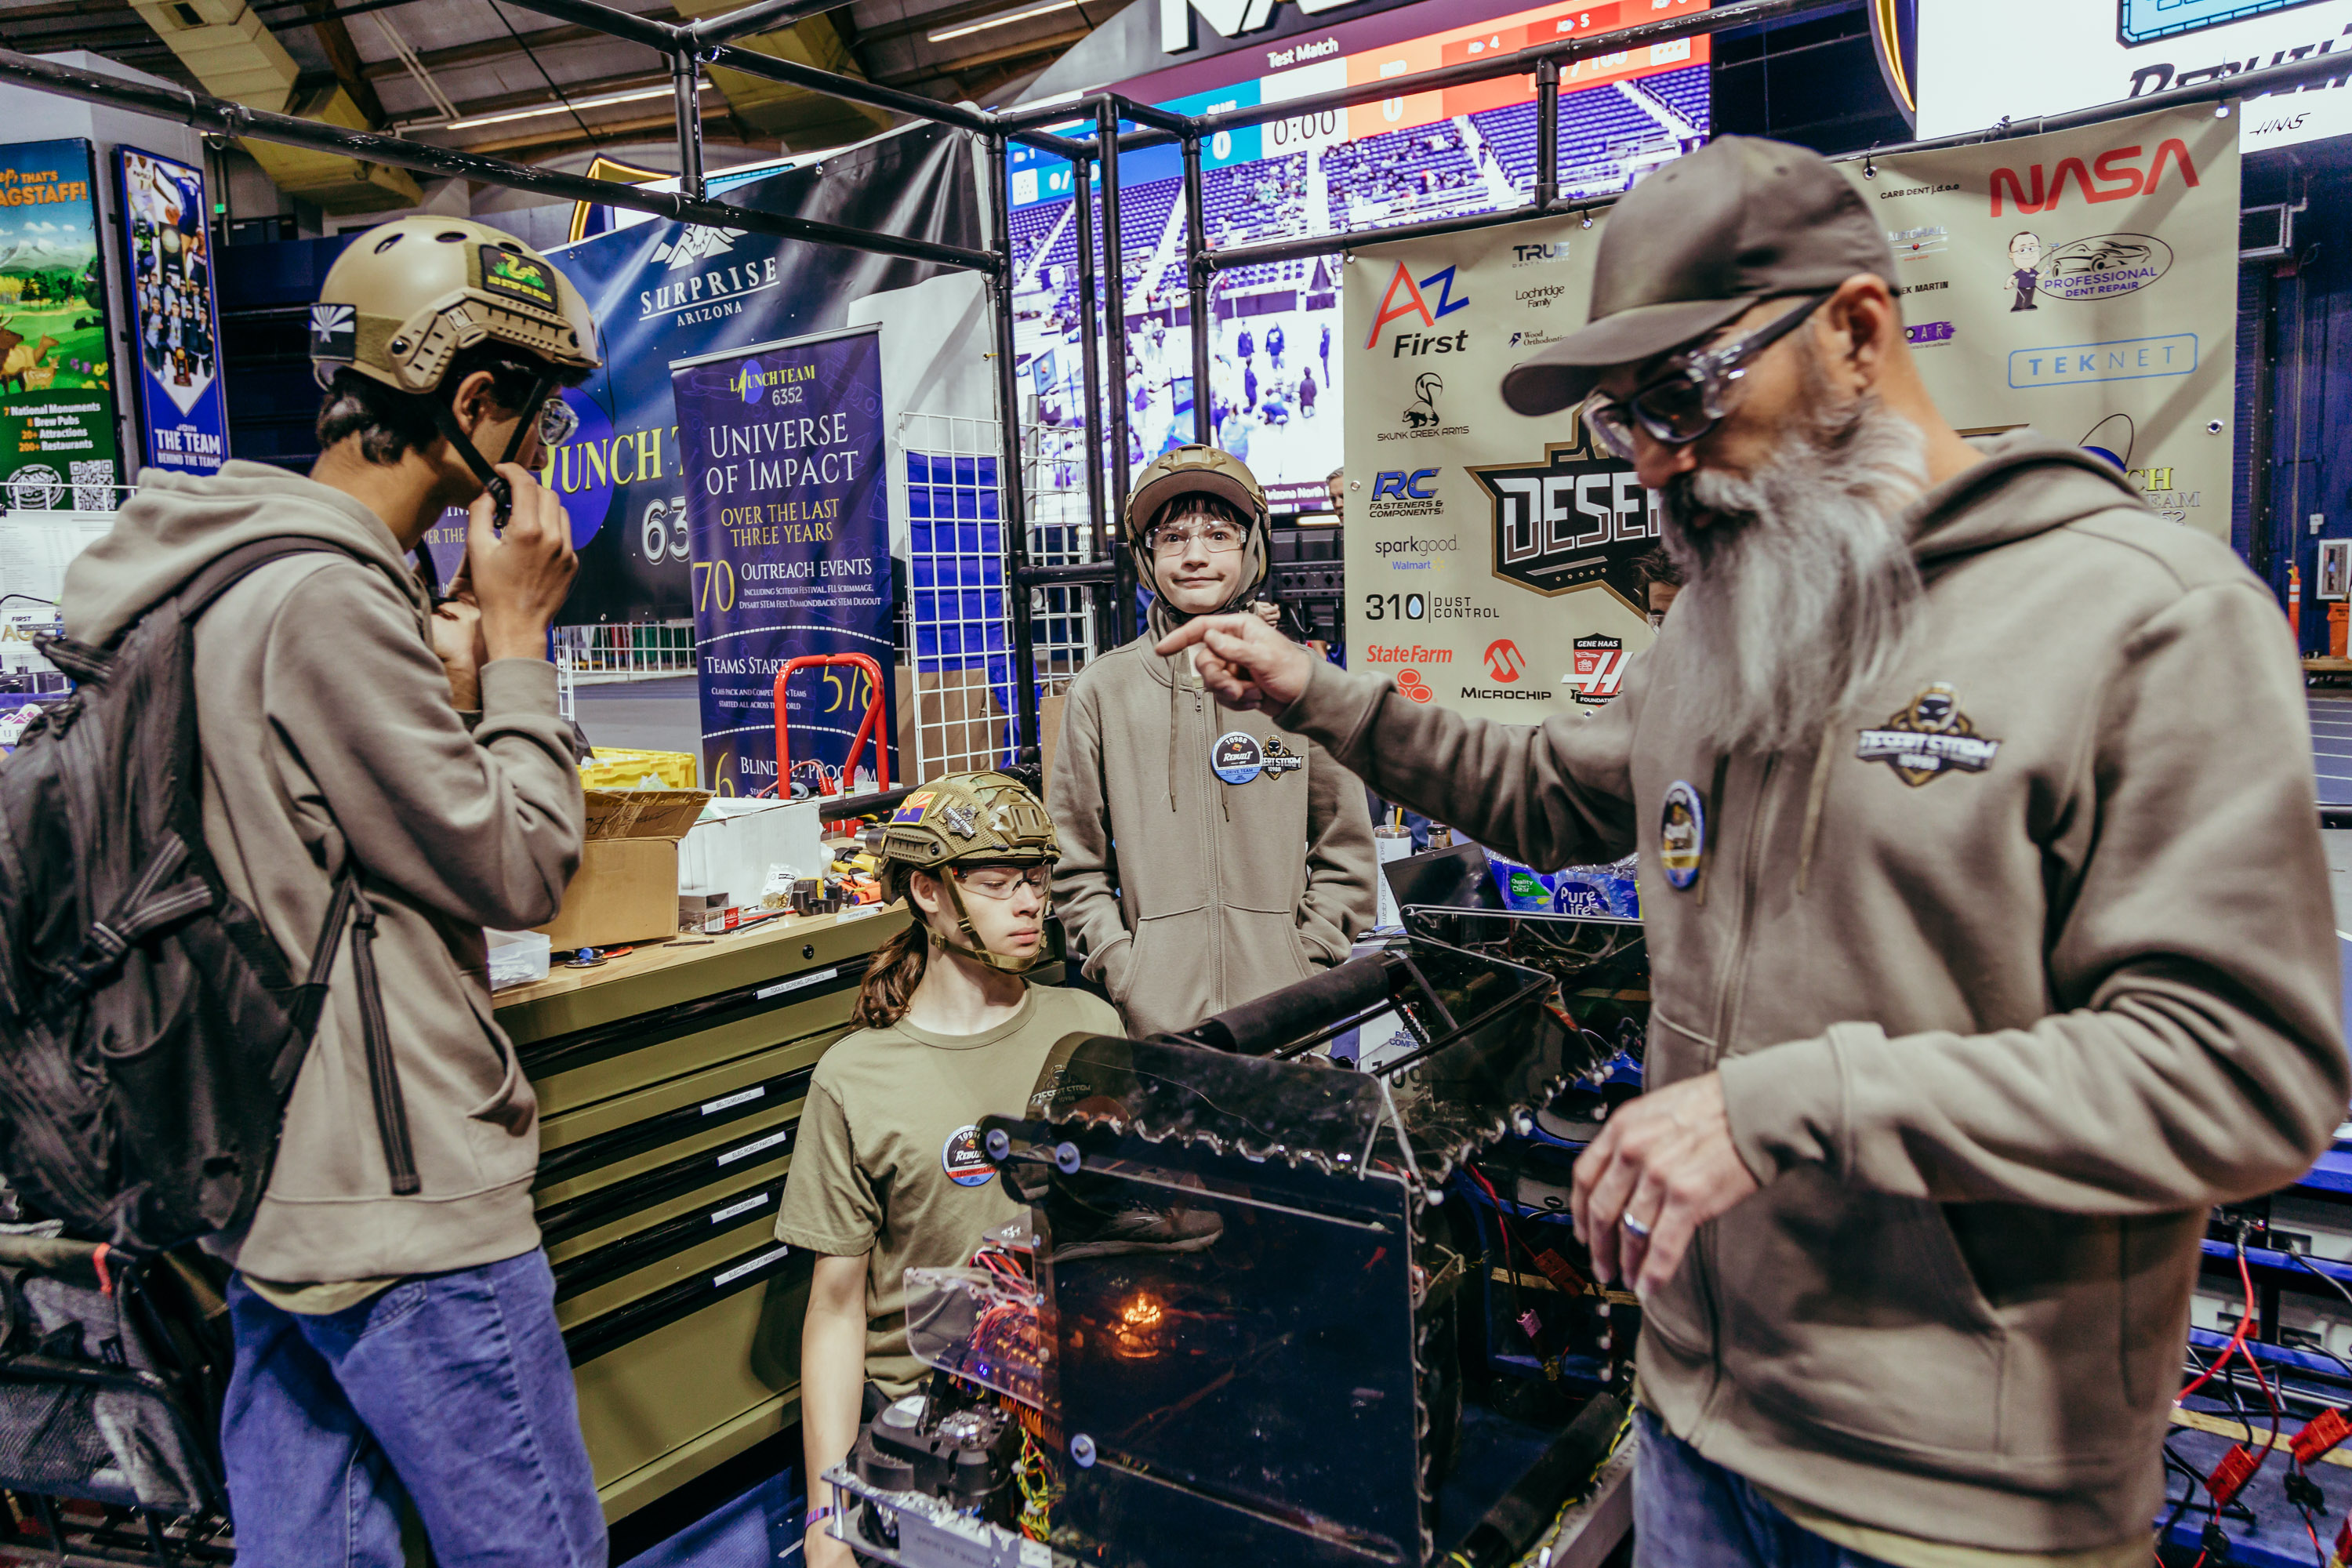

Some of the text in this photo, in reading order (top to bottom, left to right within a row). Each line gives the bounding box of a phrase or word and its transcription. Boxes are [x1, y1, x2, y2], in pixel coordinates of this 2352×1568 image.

[1580, 13, 1590, 28] 5
[1489, 35, 1501, 49] 4
[1267, 37, 1339, 69] Test Match
[1273, 110, 1336, 146] 0:00
[1212, 130, 1232, 160] 0
[20, 170, 59, 184] THAT'S
[1990, 138, 2200, 218] NASA
[1880, 190, 1904, 200] CARB
[1907, 187, 1930, 196] DENT
[1512, 241, 1570, 262] TRUE
[640, 256, 779, 315] SURPRISE
[2044, 267, 2158, 289] PROFESSIONAL
[1515, 285, 1566, 300] Lochridge
[1900, 281, 1949, 295] EK MARTIN
[2065, 281, 2140, 298] DENT REPAIR
[1527, 298, 1552, 308] Family
[677, 300, 743, 326] ARIZONA
[1524, 329, 1544, 339] Wood
[1392, 329, 1469, 358] First
[2028, 345, 2176, 376] TEKNET
[779, 365, 816, 383] TEAM
[772, 387, 804, 406] 6352
[10, 403, 48, 416] National
[49, 401, 101, 414] Monuments
[34, 416, 57, 427] Brew
[57, 415, 80, 426] Pubs
[39, 427, 88, 439] Attractions
[154, 428, 220, 455] THE TEAM
[709, 412, 849, 459] UNIVERSE
[1377, 426, 1470, 441] SKUNK CREEK ARMS
[41, 439, 93, 451] Restaurants
[158, 452, 222, 469] BEHIND THE TEAMS
[541, 427, 663, 494] UNCH
[706, 450, 859, 495] OF IMPACT
[1370, 467, 1443, 502] RC
[1369, 500, 1433, 510] FASTENERS
[2146, 491, 2201, 510] EAM
[720, 499, 840, 527] OVER THE LAST
[1369, 508, 1441, 517] COMPONENTS
[442, 527, 466, 543] THE
[641, 495, 691, 566] 63
[729, 521, 834, 547] THREE YEARS
[1374, 534, 1458, 558] sparkgood
[1392, 561, 1432, 570] Walmart
[692, 557, 873, 613] 70 OUTREACH EVENTS
[744, 588, 775, 597] INCLUDING
[739, 599, 760, 610] DYSART
[760, 599, 775, 608] STEM
[838, 597, 852, 607] STEM
[853, 597, 882, 606] DUGOUT
[1365, 593, 1472, 621] 310 DUST
[1434, 607, 1500, 619] CONTROL
[704, 656, 745, 674] TEAMS
[739, 688, 752, 696] AND
[790, 688, 807, 697] TEAMS
[1461, 687, 1552, 700] MICROCHIP
[786, 702, 801, 710] ORLD
[1225, 736, 1248, 746] 10988
[1223, 751, 1254, 762] REBUILT
[1275, 757, 1302, 768] STORM
[715, 752, 735, 798] 6
[740, 757, 779, 776] BLIND
[1560, 886, 1596, 904] Pure
[1388, 1038, 1418, 1049] COMPE
